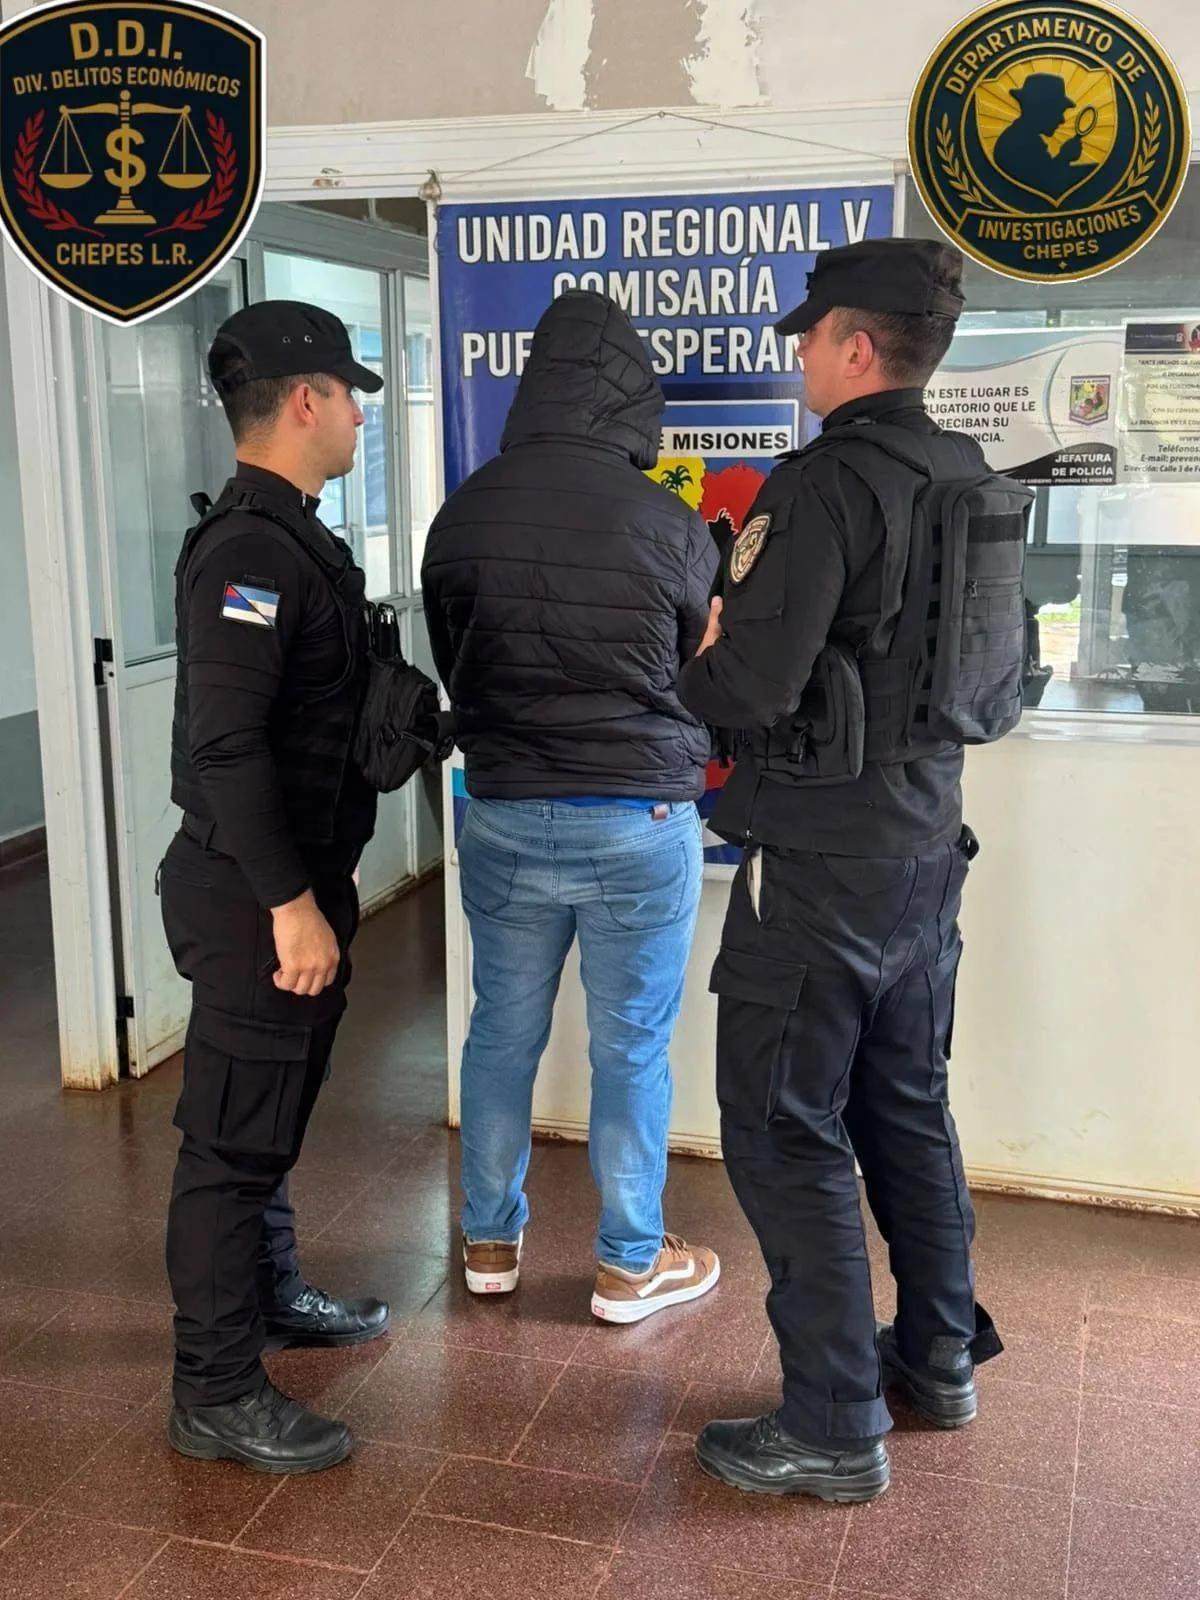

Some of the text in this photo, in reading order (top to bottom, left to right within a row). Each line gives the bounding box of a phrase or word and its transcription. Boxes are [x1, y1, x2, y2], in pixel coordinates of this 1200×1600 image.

[457, 200, 871, 264] UNIDAD REGIONAL V
[637, 326, 805, 374] SPERAN
[922, 386, 1029, 399] EN ESTE LUGAR ES
[924, 401, 1036, 414] BLIGATORIO QUE LE
[937, 417, 1009, 428] RECIBAN SU
[672, 432, 789, 450] MISIONES
[1055, 453, 1112, 463] JEFATURA
[1141, 454, 1168, 462] E-mail:
[1051, 465, 1114, 476] DE POLICÍA
